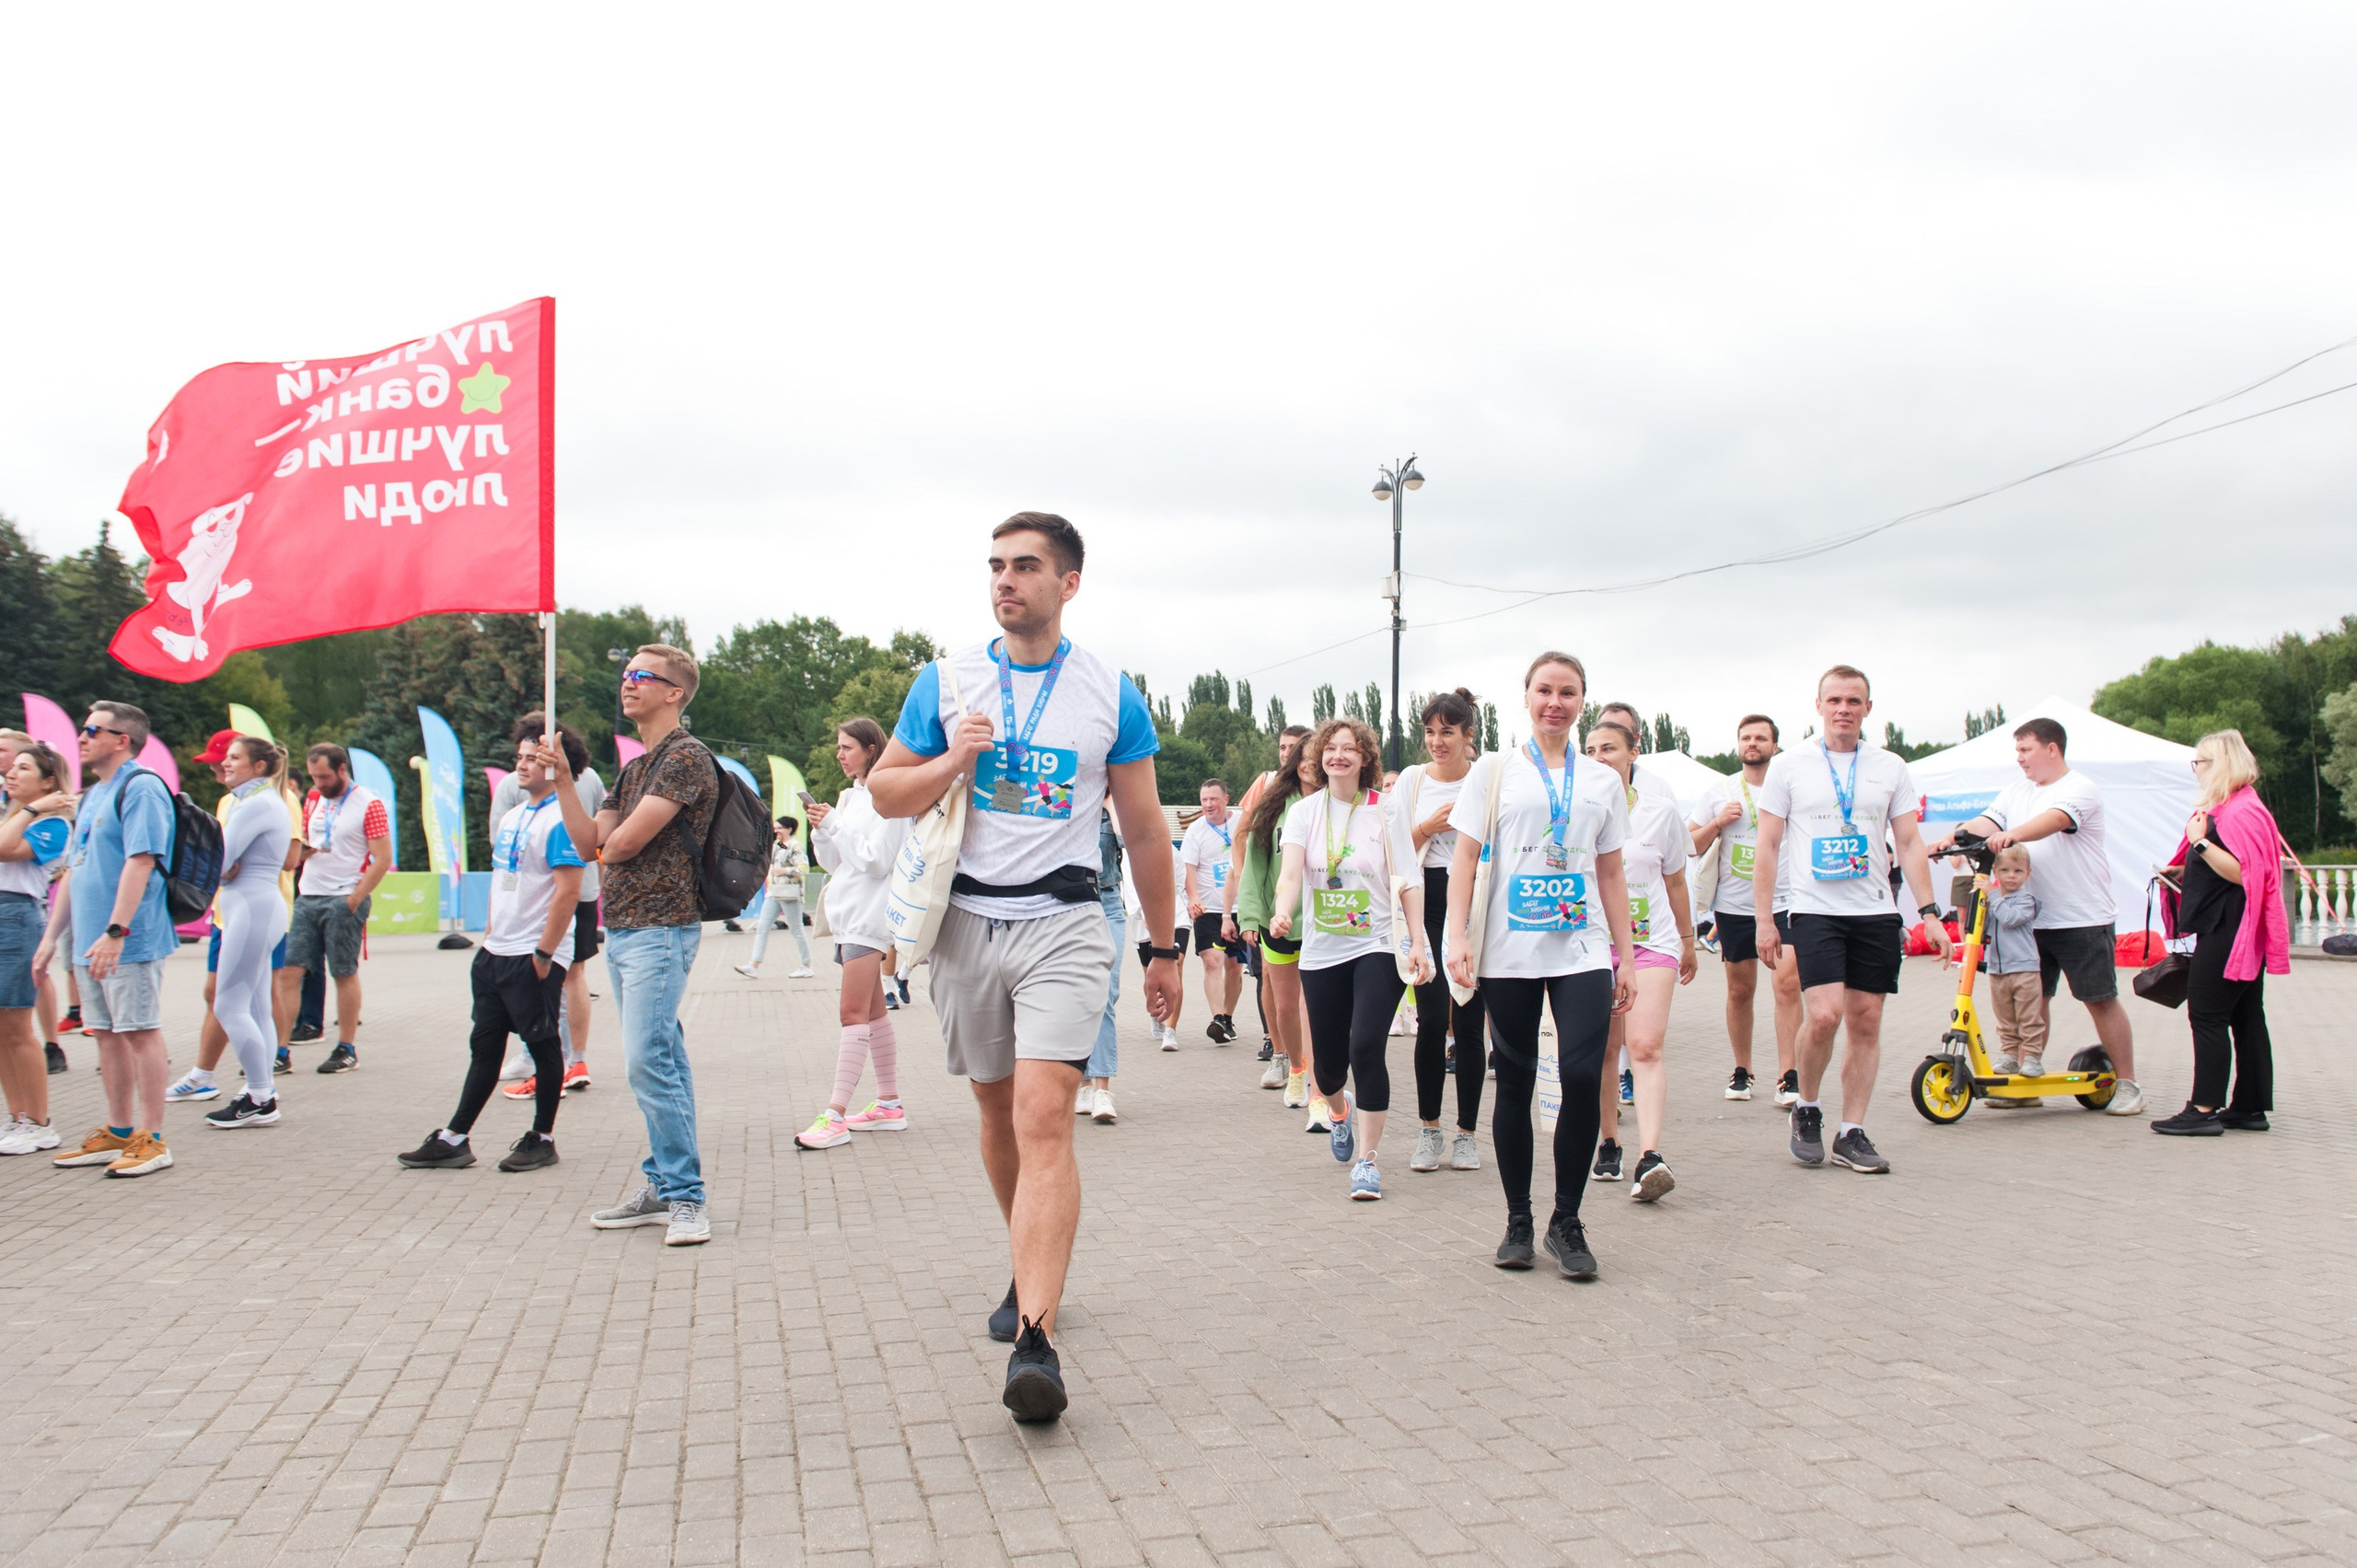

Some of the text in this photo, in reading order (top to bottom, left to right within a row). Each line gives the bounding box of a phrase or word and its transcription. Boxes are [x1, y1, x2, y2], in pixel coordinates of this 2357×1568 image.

[994, 747, 1058, 774] 3219
[1821, 838, 1860, 854] 3212
[1518, 878, 1575, 898] 3202
[1320, 892, 1359, 908] 1324
[886, 902, 907, 928] АКЕТ
